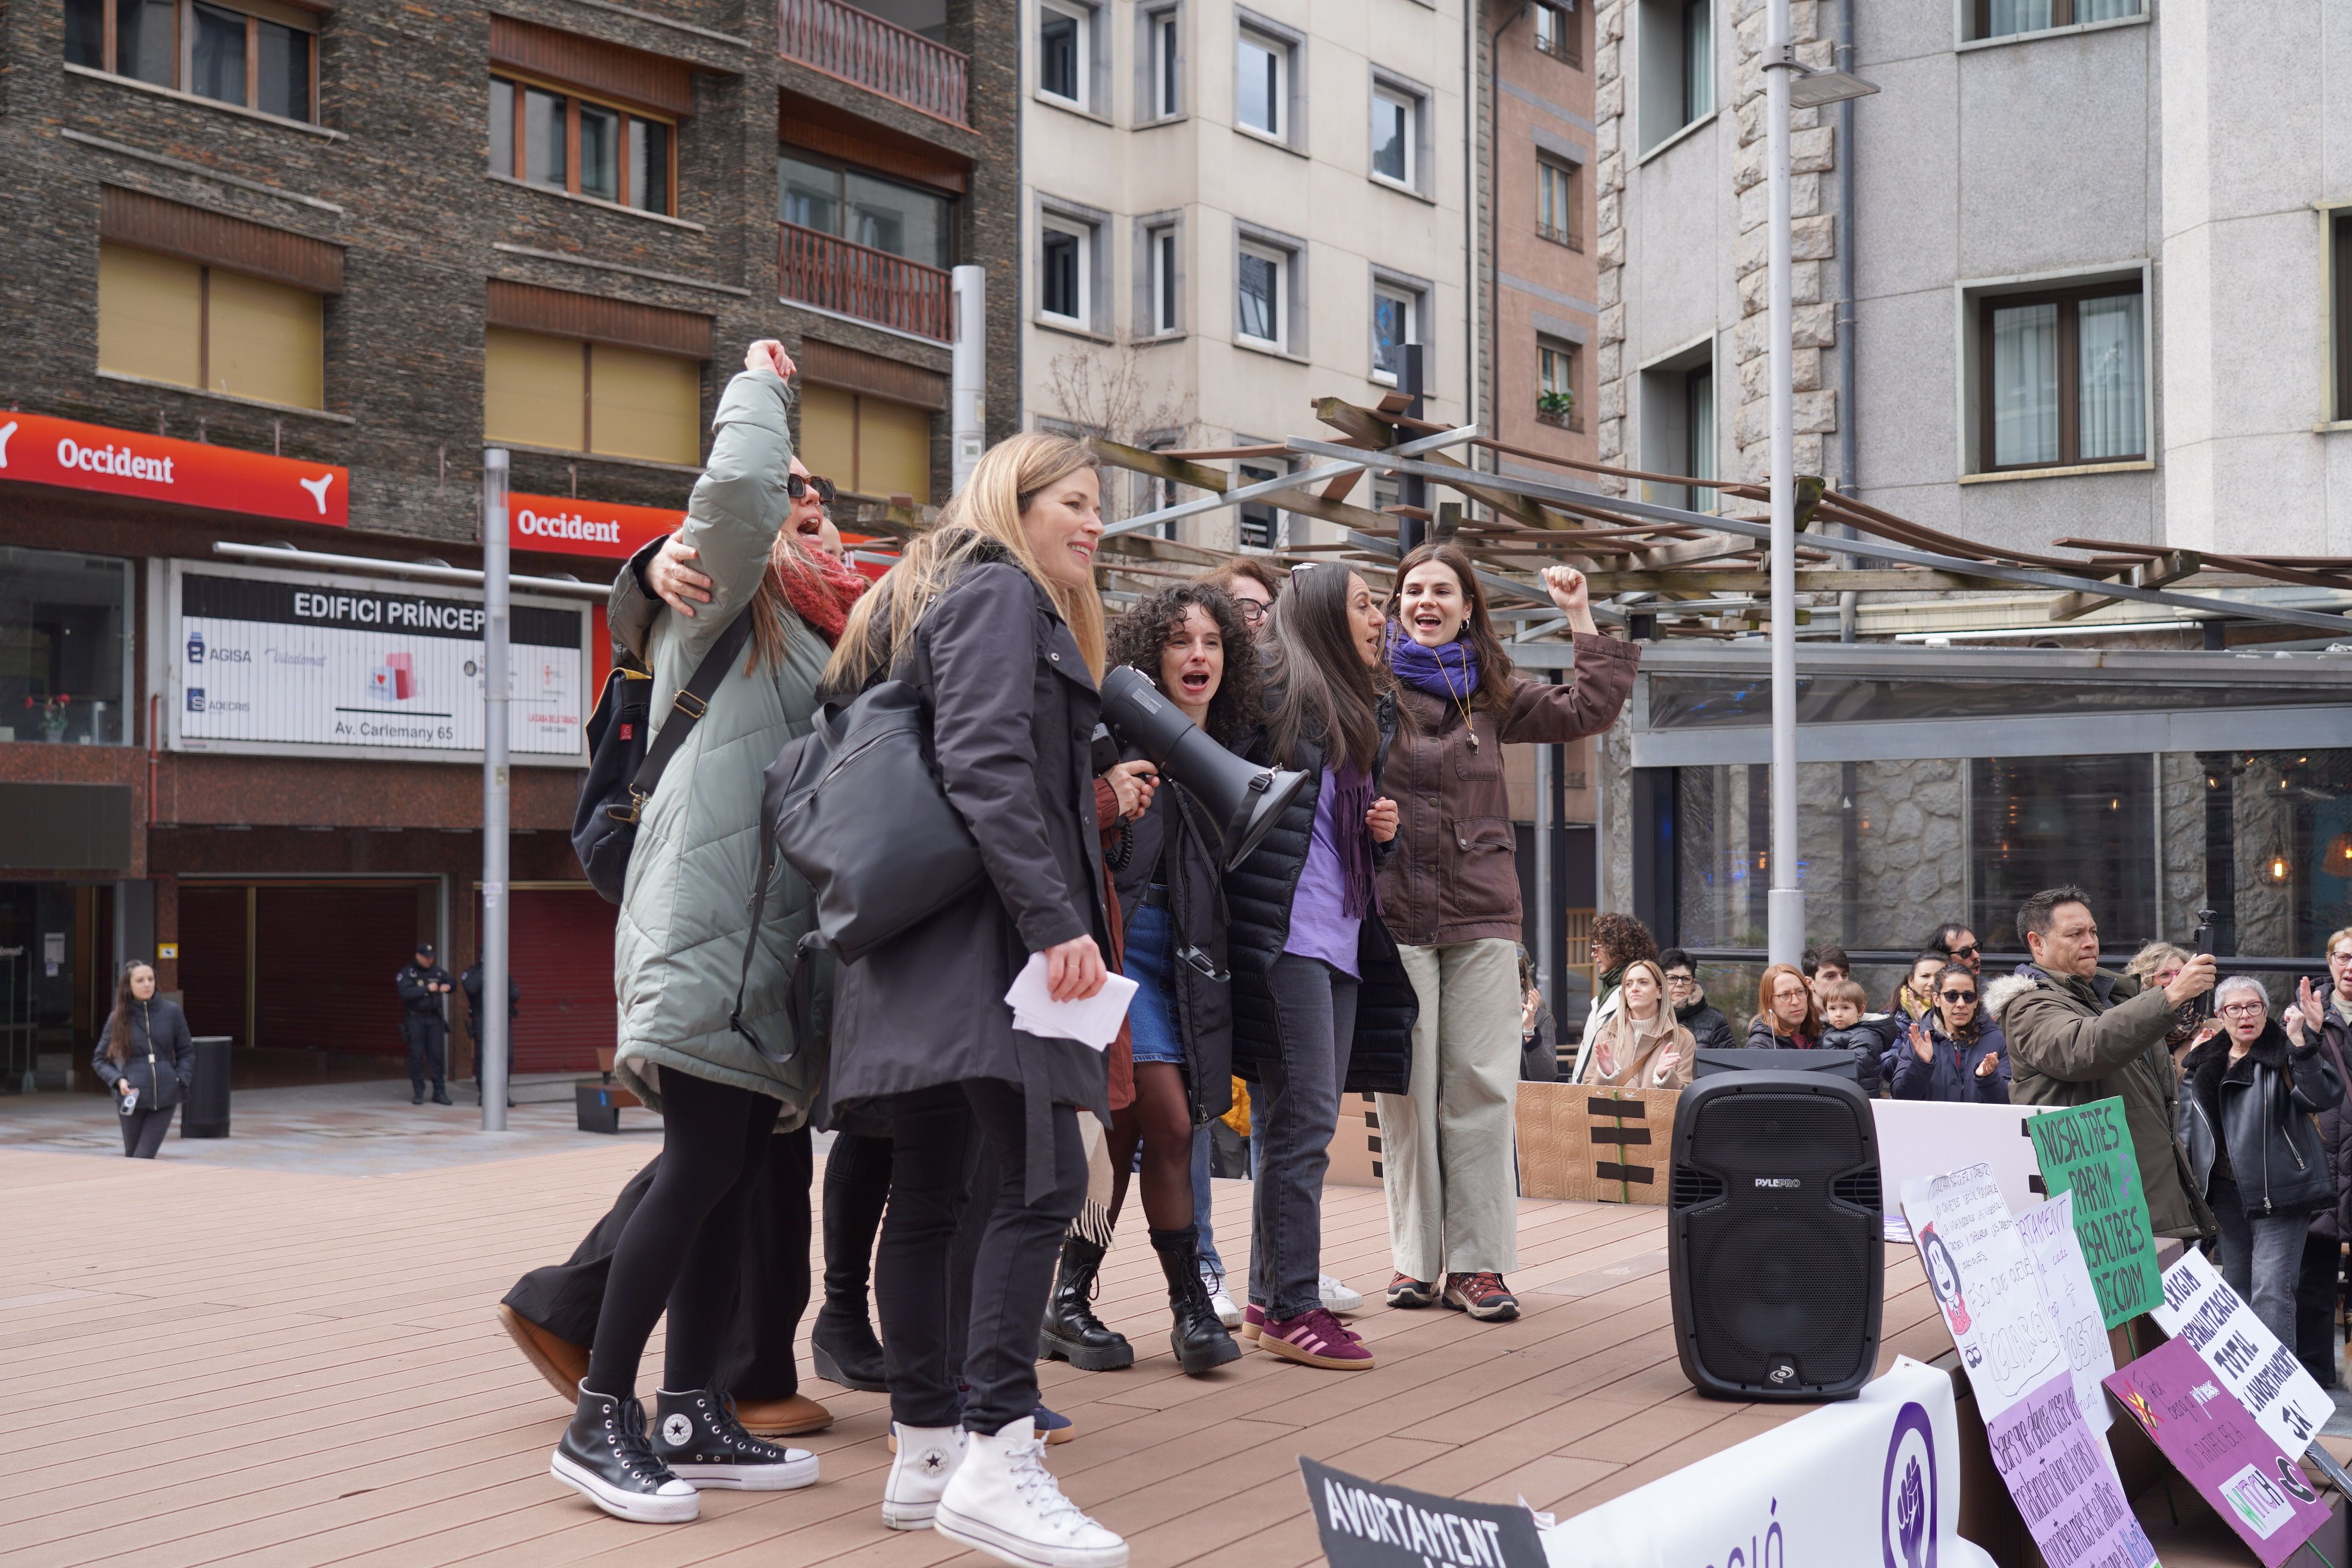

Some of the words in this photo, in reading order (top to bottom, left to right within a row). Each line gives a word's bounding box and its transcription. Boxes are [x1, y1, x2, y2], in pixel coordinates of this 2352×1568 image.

[57, 437, 174, 483] Occident
[517, 509, 620, 543] Occident
[294, 592, 381, 624] EDIFICI
[210, 648, 252, 663] AGISA
[335, 721, 355, 735] Av.
[360, 722, 433, 742] Carlemany
[437, 726, 453, 740] 65
[2036, 1105, 2119, 1168] NOSALTRES
[1755, 1178, 1800, 1187] PYLEPRO
[2068, 1160, 2117, 1215] PARIM
[2053, 1242, 2068, 1266] cada
[2076, 1205, 2145, 1271] OSALTRES
[1969, 1282, 1990, 1318] ESO
[1991, 1273, 2008, 1302] QUE
[2010, 1257, 2034, 1286] QUEDE
[2094, 1261, 2146, 1320] DECIDIM
[2164, 1266, 2201, 1312] EXIGIM
[2213, 1330, 2259, 1380] TOTAL
[1988, 1422, 2022, 1475] Saps
[2013, 1421, 2035, 1457] que
[2028, 1402, 2057, 1449] alguna
[2048, 1394, 2072, 1434] cosa
[2065, 1386, 2082, 1421] va
[2159, 1398, 2197, 1422] being
[2185, 1395, 2195, 1408] a
[2228, 1421, 2246, 1441] A
[2282, 1399, 2313, 1441] JA!
[2071, 1437, 2094, 1480] país
[2078, 1428, 2100, 1468] li
[2194, 1432, 2230, 1463] RATHER
[2218, 1425, 2240, 1447] BE
[2050, 1457, 2078, 1497] quan
[2062, 1440, 2084, 1485] al
[2012, 1456, 2063, 1529] malament
[2091, 1481, 2124, 1531] edificis
[2225, 1469, 2284, 1531] WITCH
[1324, 1477, 1506, 1568] AVORTAMENT
[2069, 1509, 2095, 1552] més
[2080, 1494, 2105, 1539] els
[2038, 1518, 2081, 1568] importen
